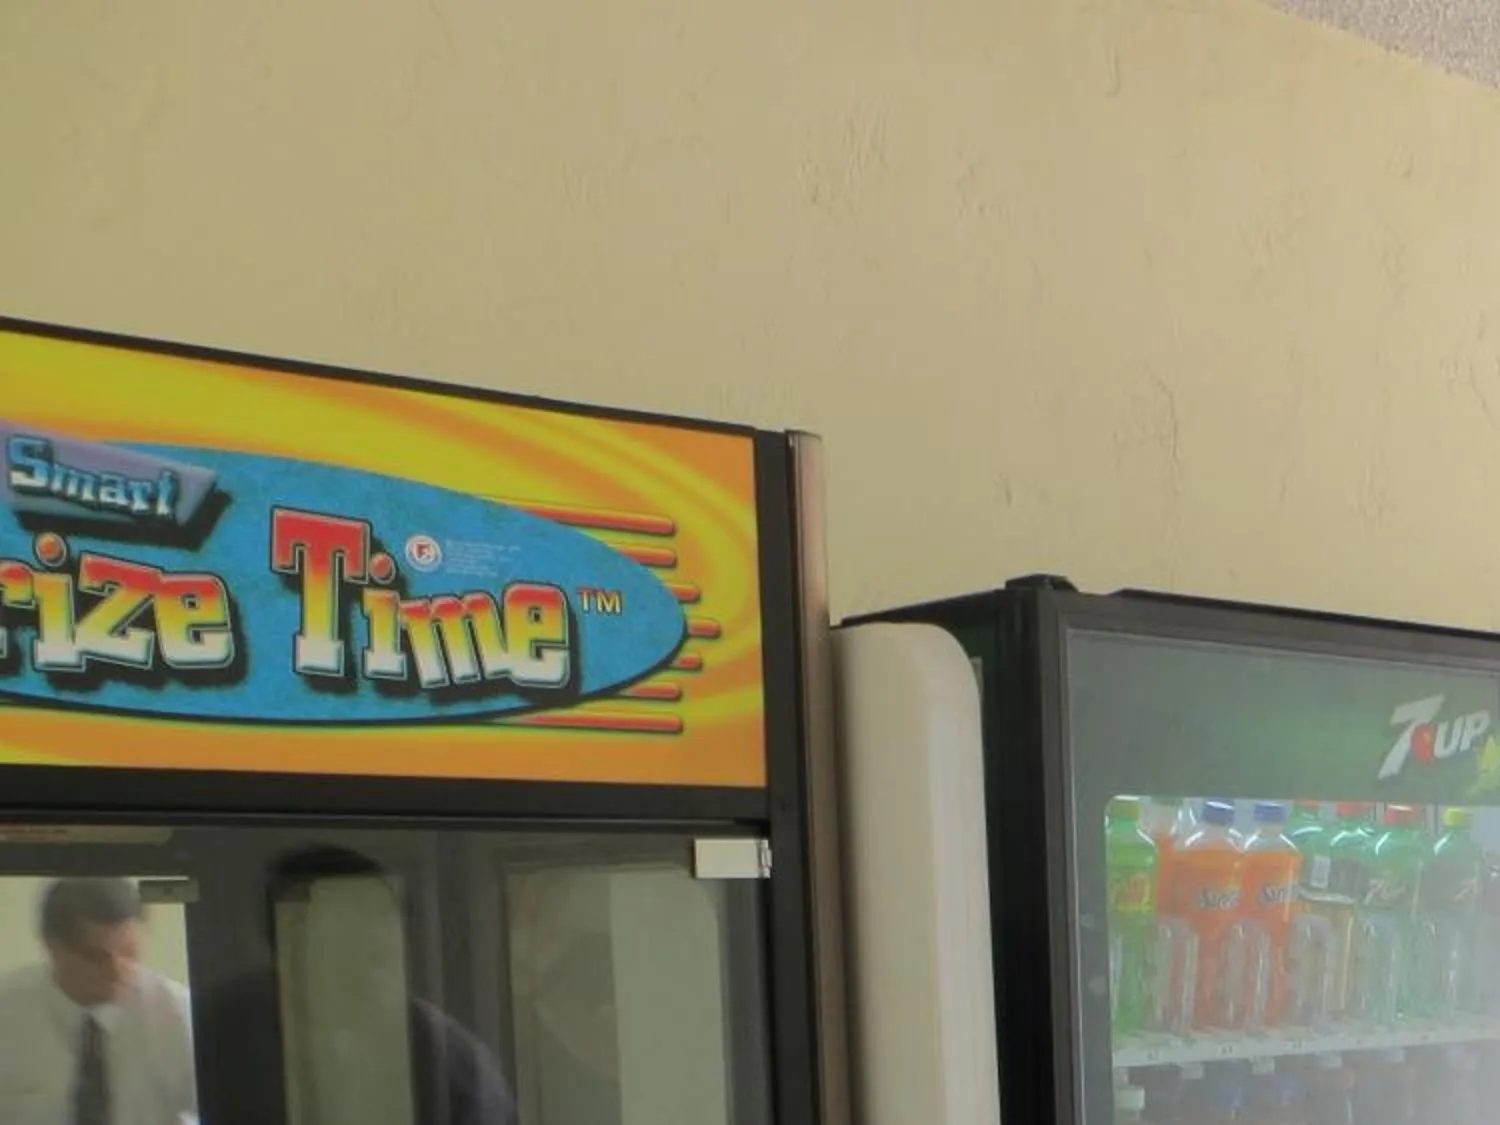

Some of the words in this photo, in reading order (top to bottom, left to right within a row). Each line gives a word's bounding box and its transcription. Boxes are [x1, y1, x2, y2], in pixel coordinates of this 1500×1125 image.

[8, 436, 177, 518] Smart
[271, 506, 572, 689] Time
[1378, 693, 1491, 780] 7UP
